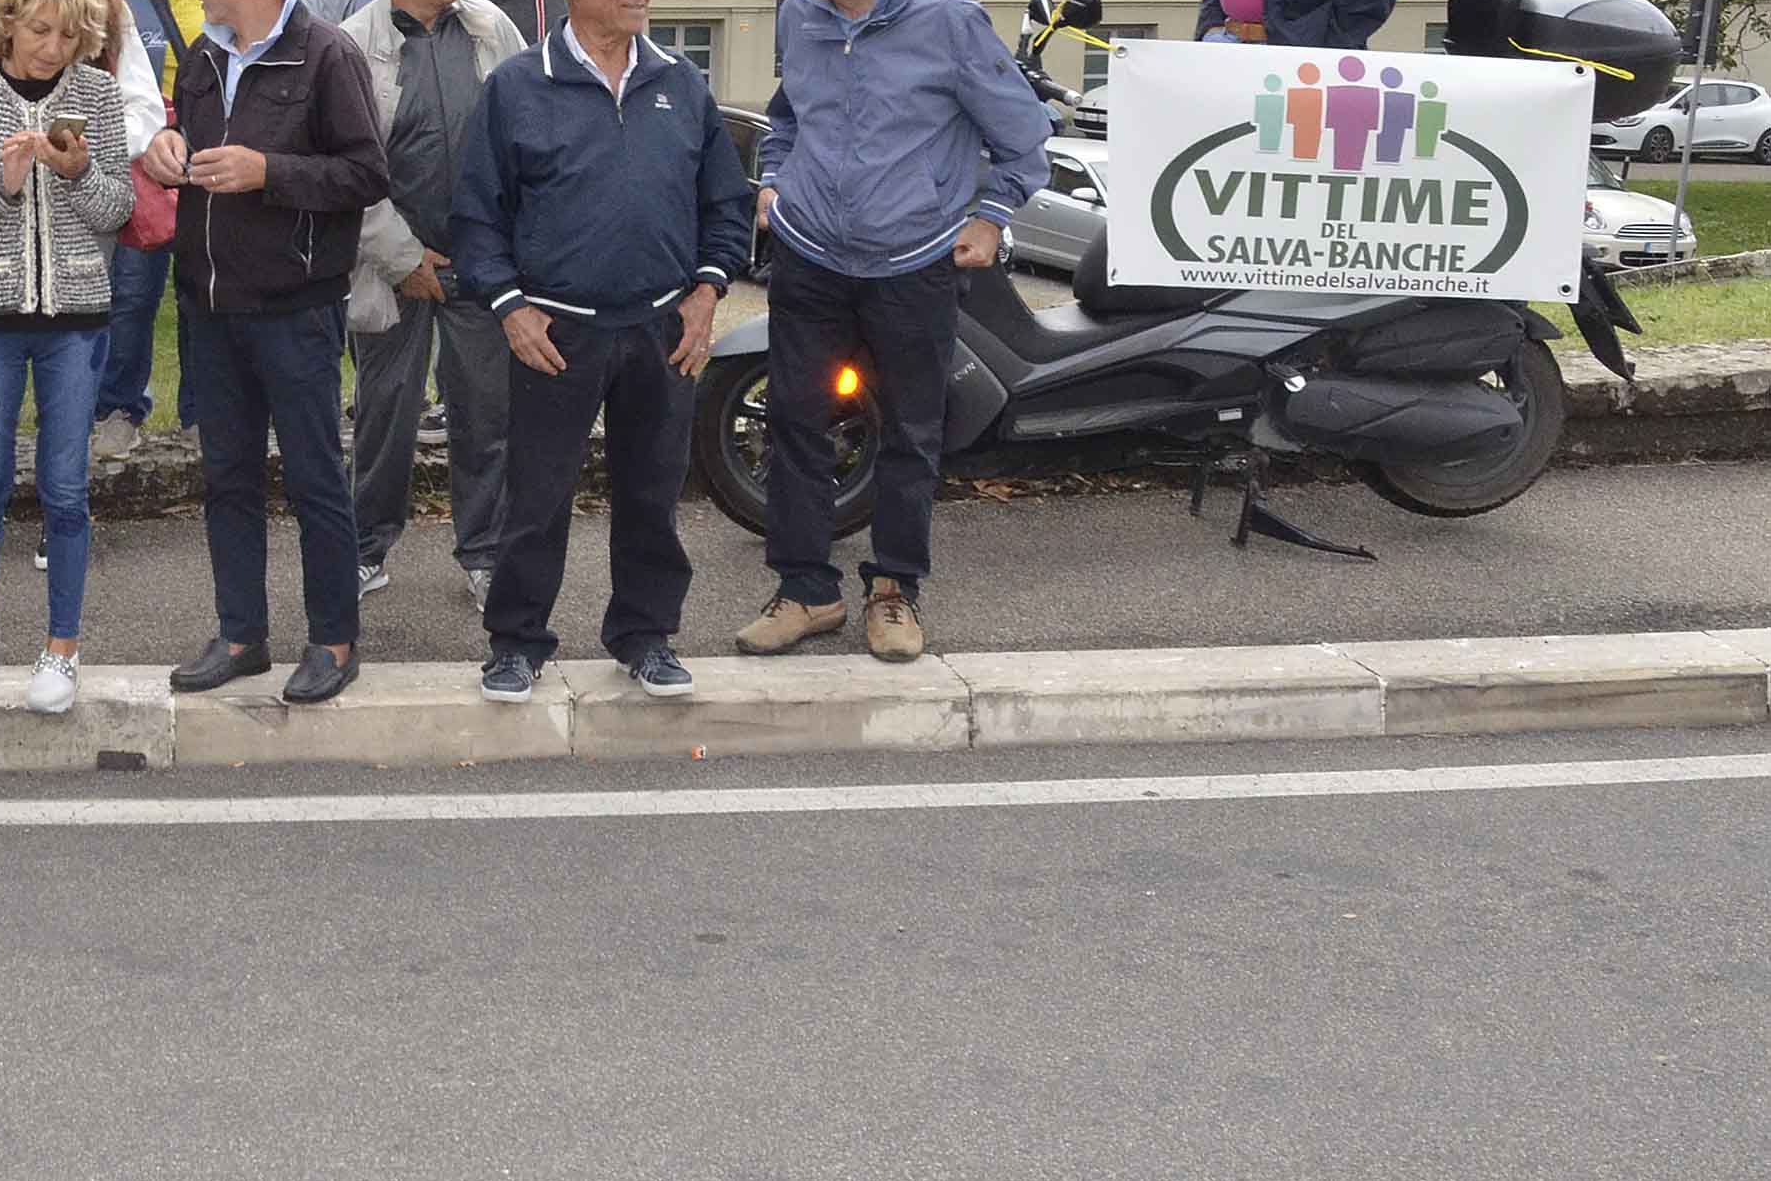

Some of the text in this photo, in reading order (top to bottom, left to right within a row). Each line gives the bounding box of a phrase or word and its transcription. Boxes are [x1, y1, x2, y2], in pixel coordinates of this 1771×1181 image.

[1192, 168, 1494, 227] VITTIME
[1320, 221, 1358, 241] DEL
[1207, 234, 1467, 273] SALVA-BANCHE
[1180, 266, 1490, 294] www.vittimedelsalvabanche.it
